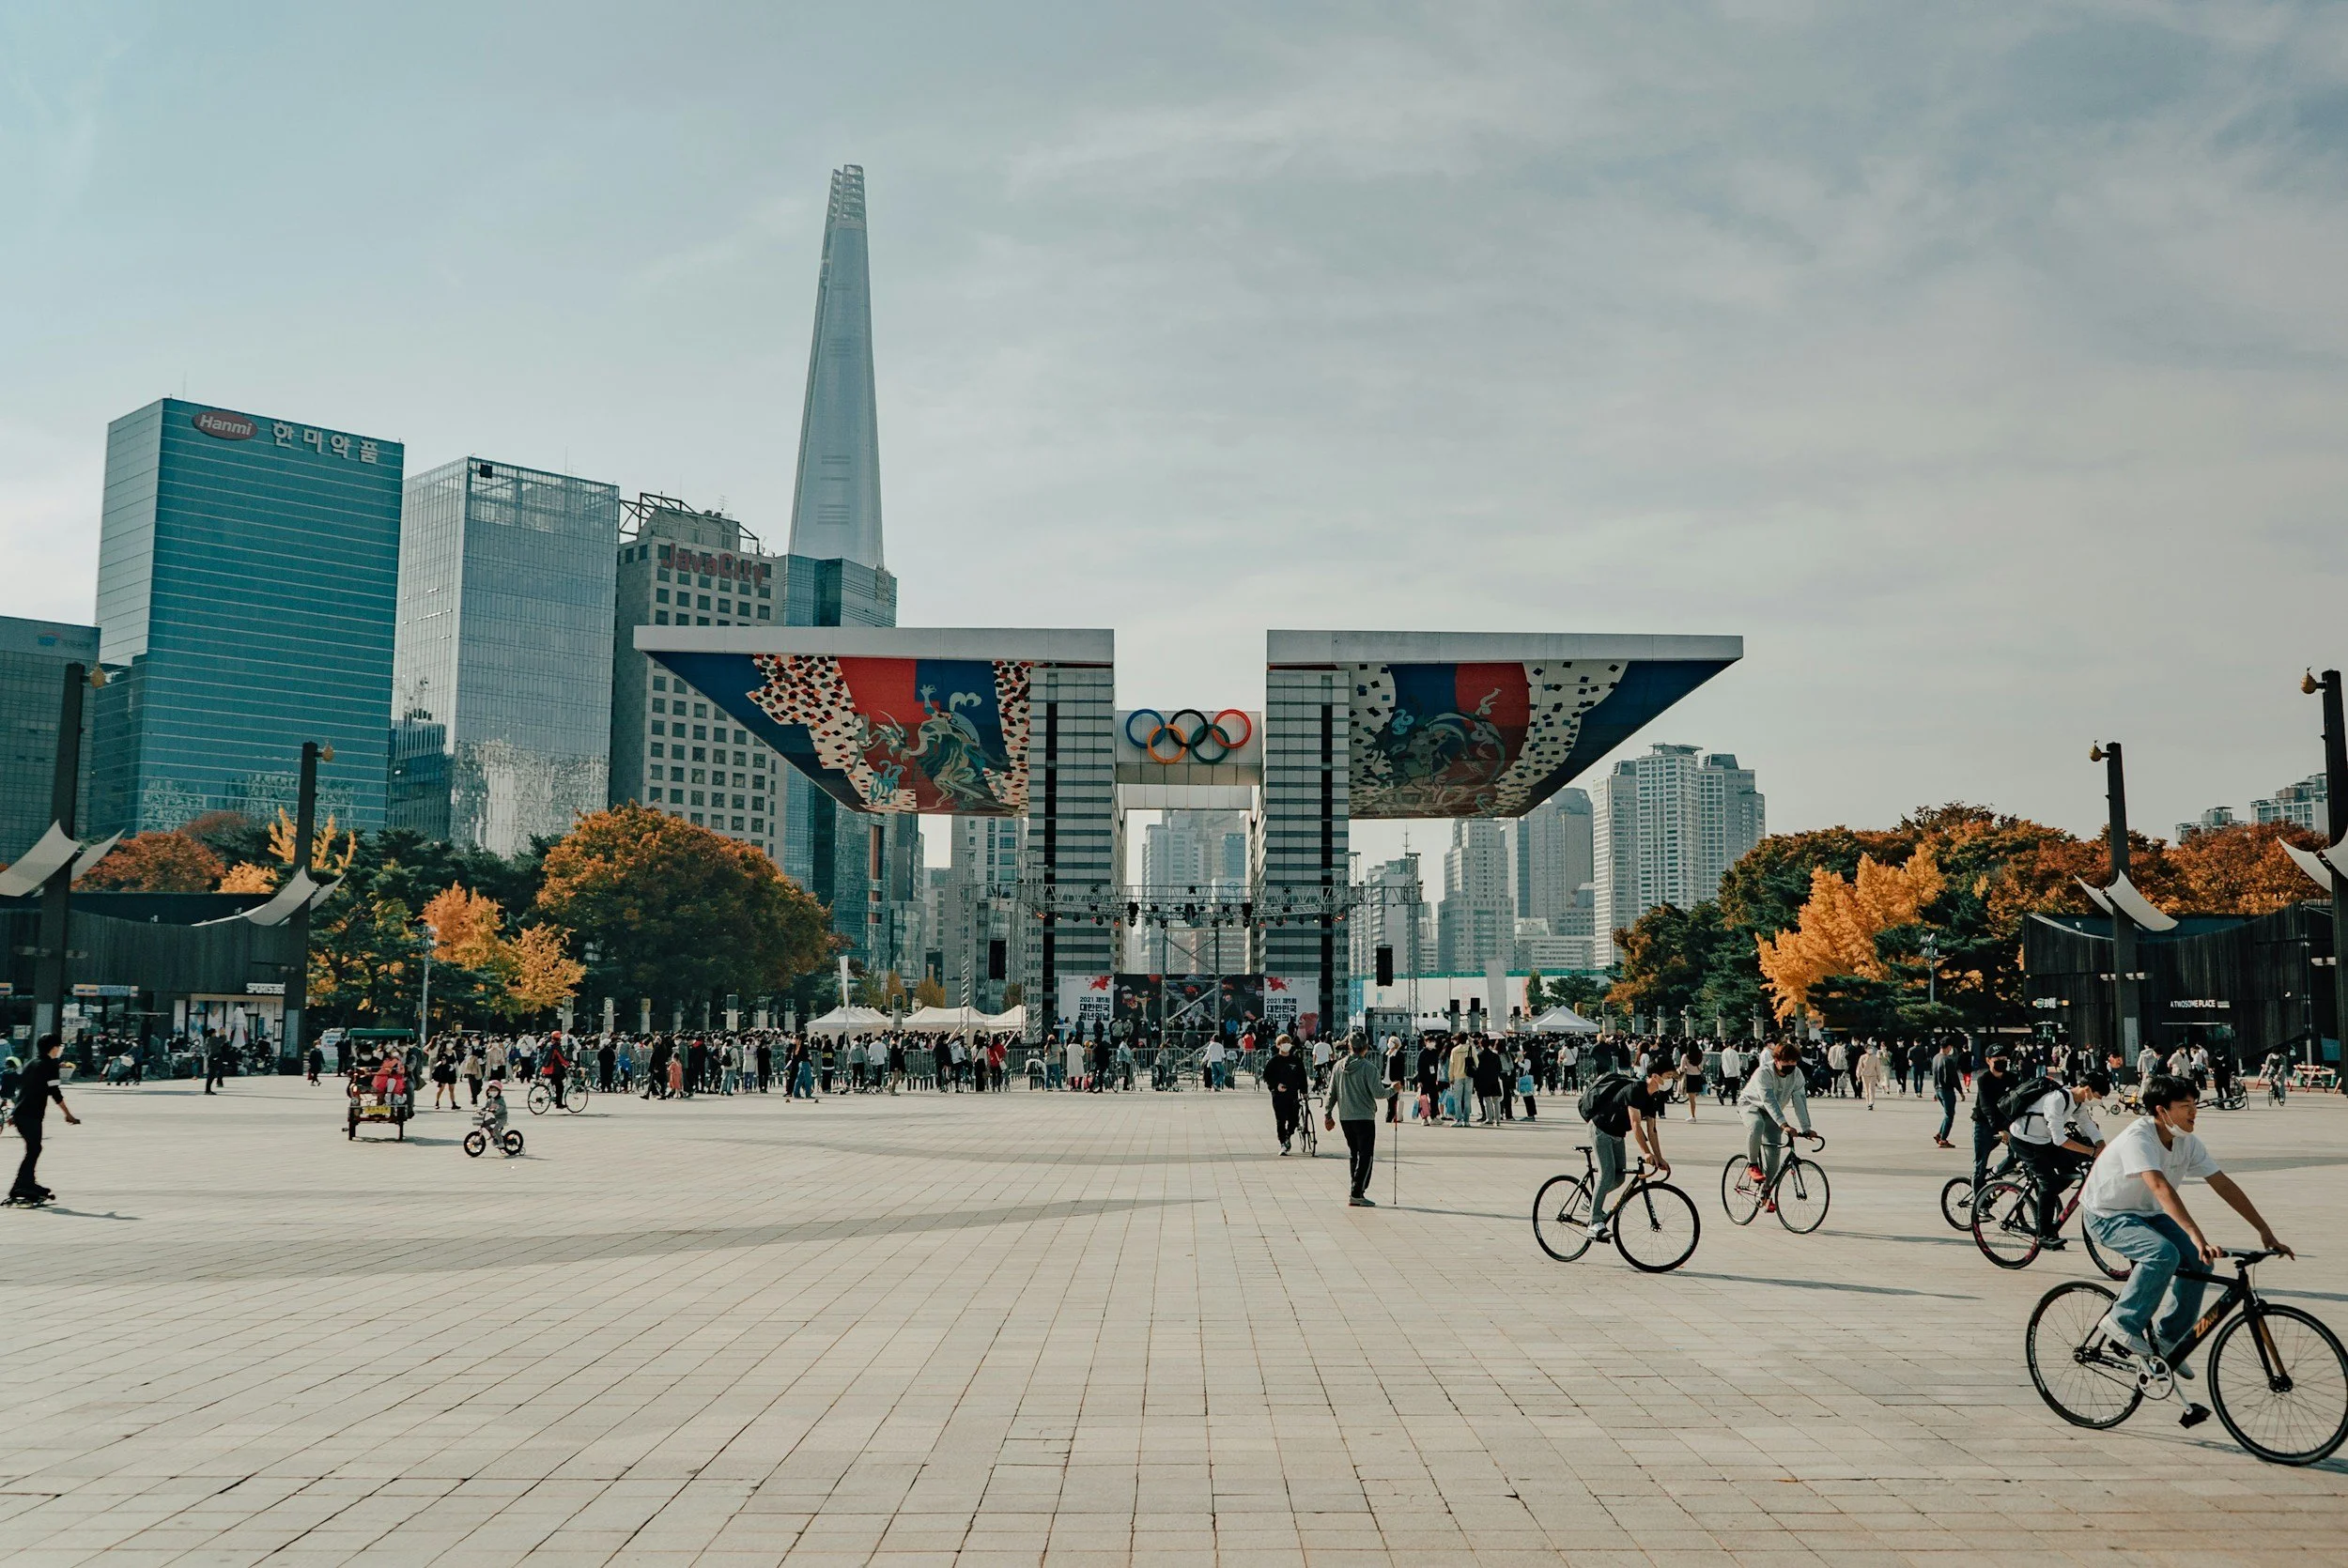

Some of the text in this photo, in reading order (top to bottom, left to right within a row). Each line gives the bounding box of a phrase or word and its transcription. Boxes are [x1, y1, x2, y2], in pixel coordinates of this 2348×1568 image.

[200, 414, 253, 436] Hanmi
[271, 422, 378, 464] 한미약품
[1079, 1003, 1110, 1012] 대한민국
[2198, 999, 2217, 1008] PLACE
[1266, 1005, 1297, 1013] 대한민국
